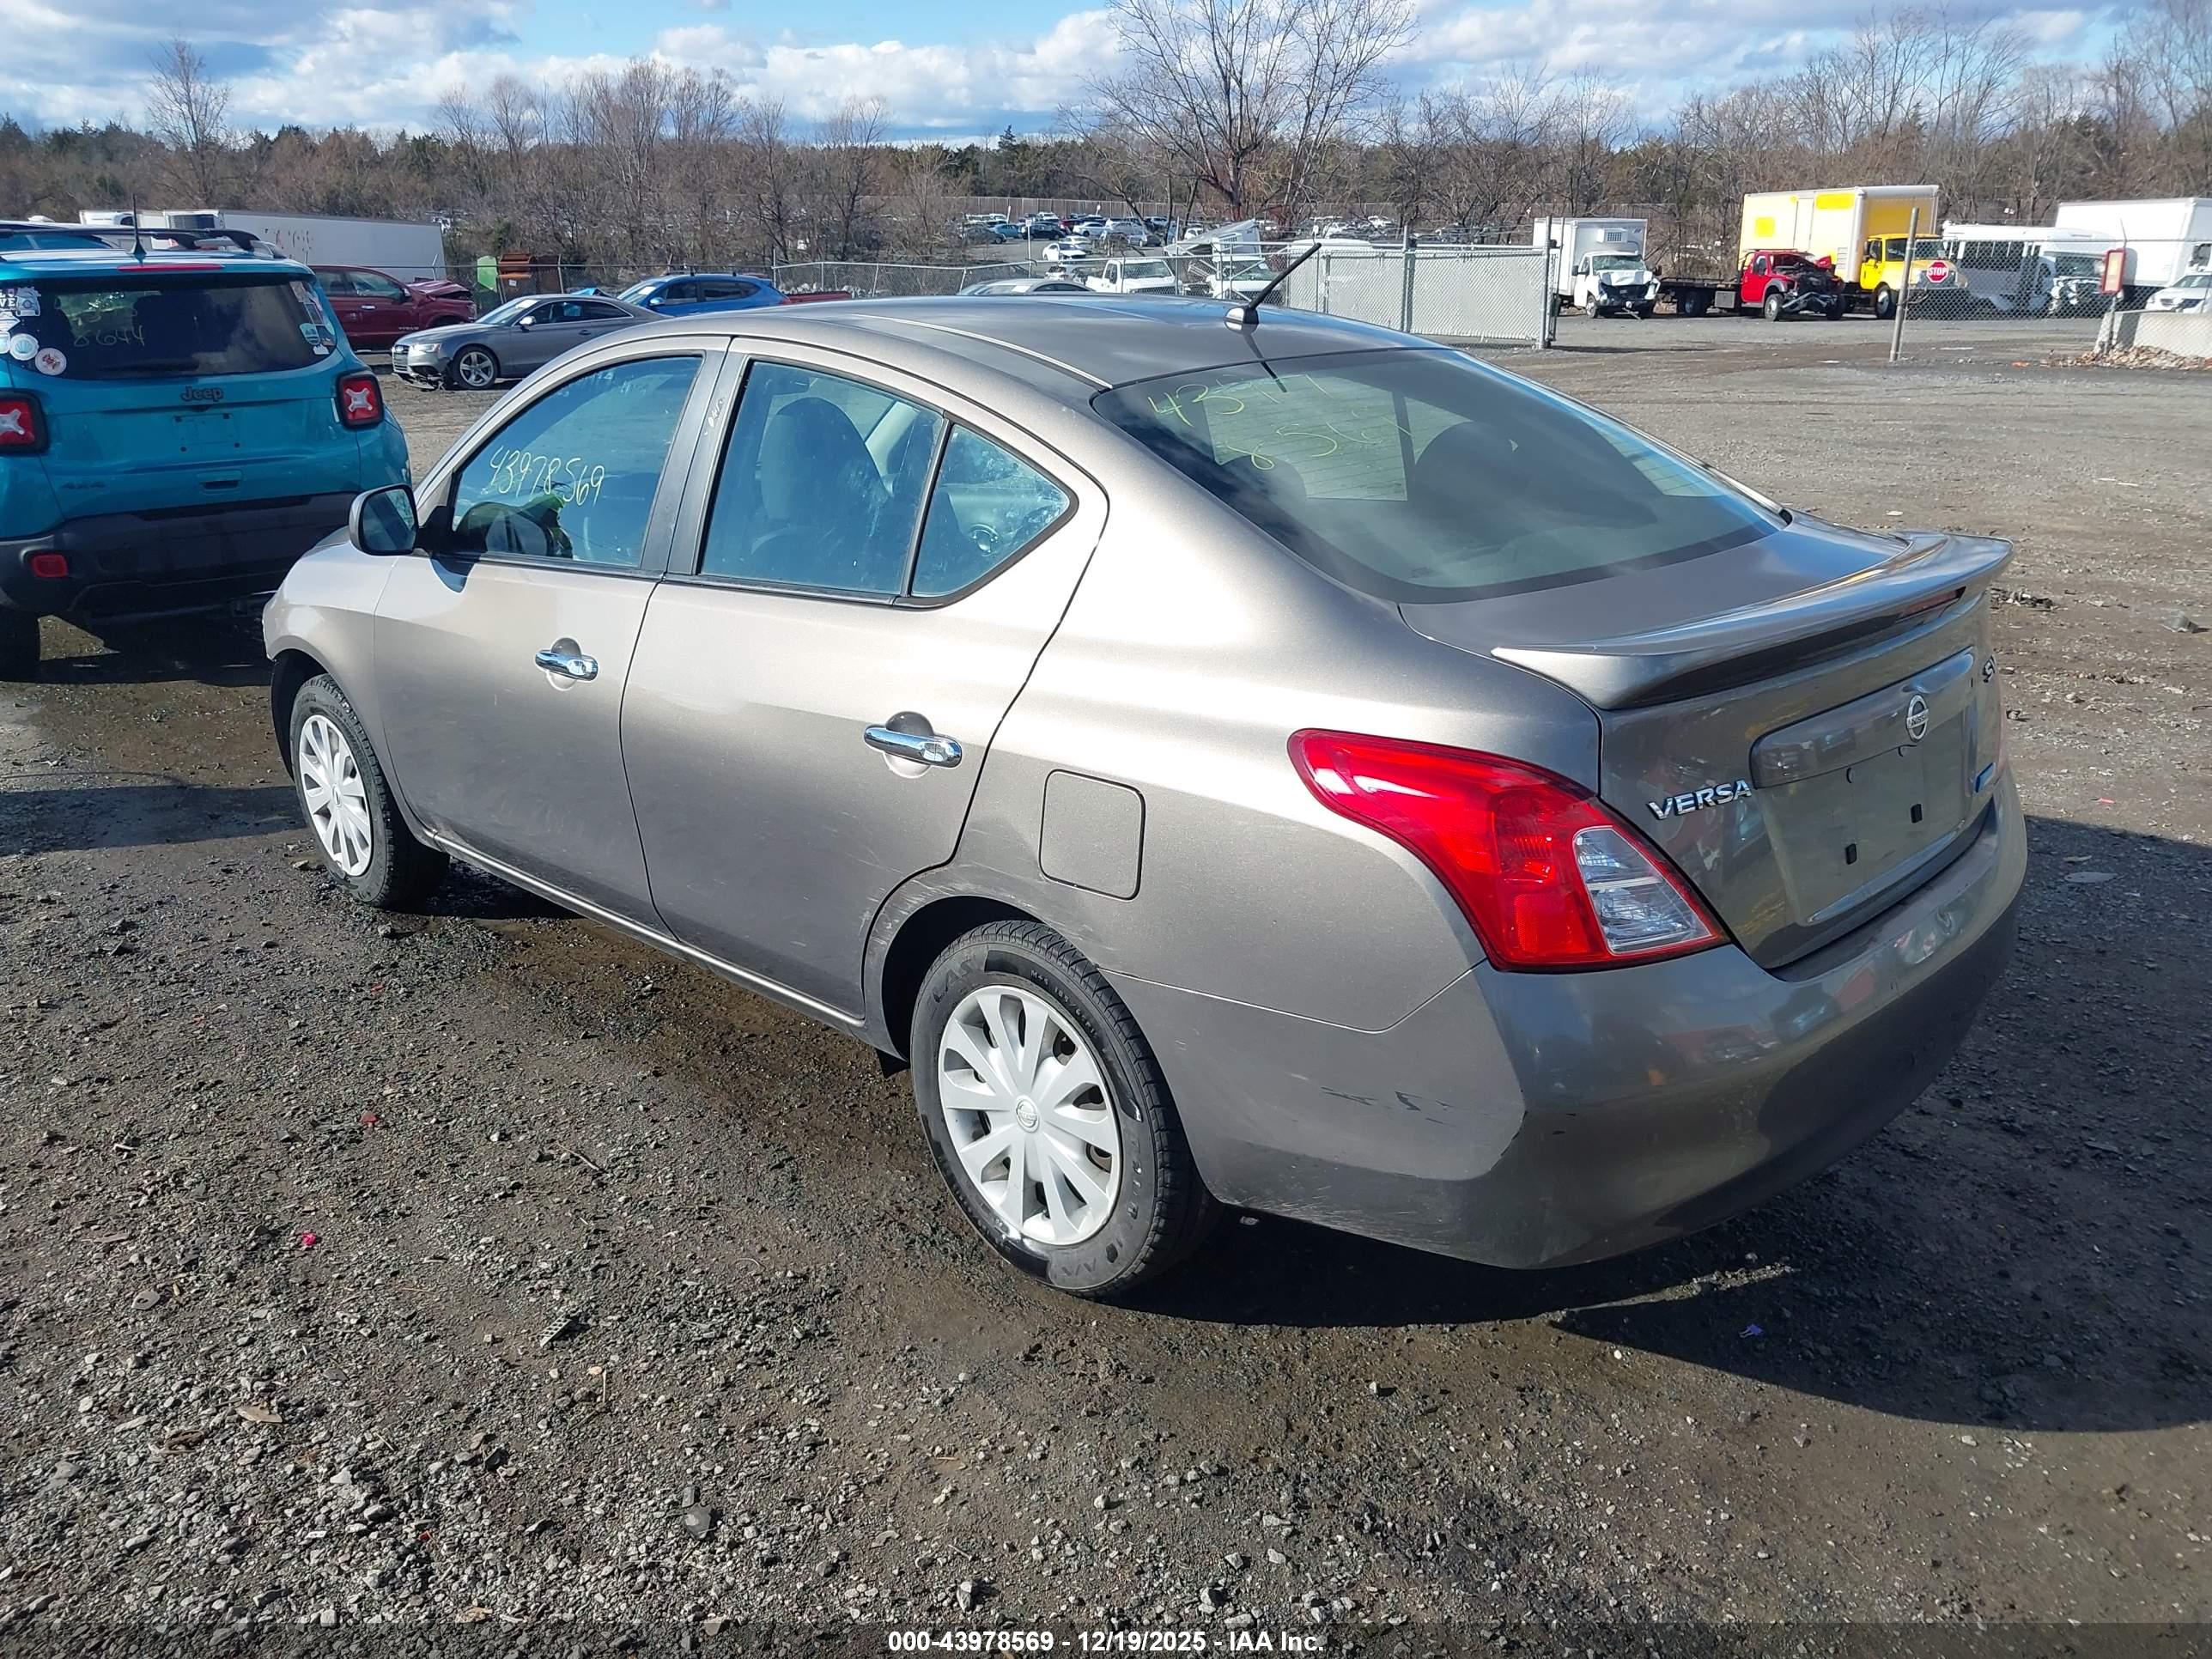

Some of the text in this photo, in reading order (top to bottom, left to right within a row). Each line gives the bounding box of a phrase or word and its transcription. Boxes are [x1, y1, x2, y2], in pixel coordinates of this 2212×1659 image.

[1928, 266, 1948, 276] STOP
[180, 386, 224, 402] Jeep
[489, 445, 605, 507] 43978569
[1646, 778, 1752, 820] VERSA
